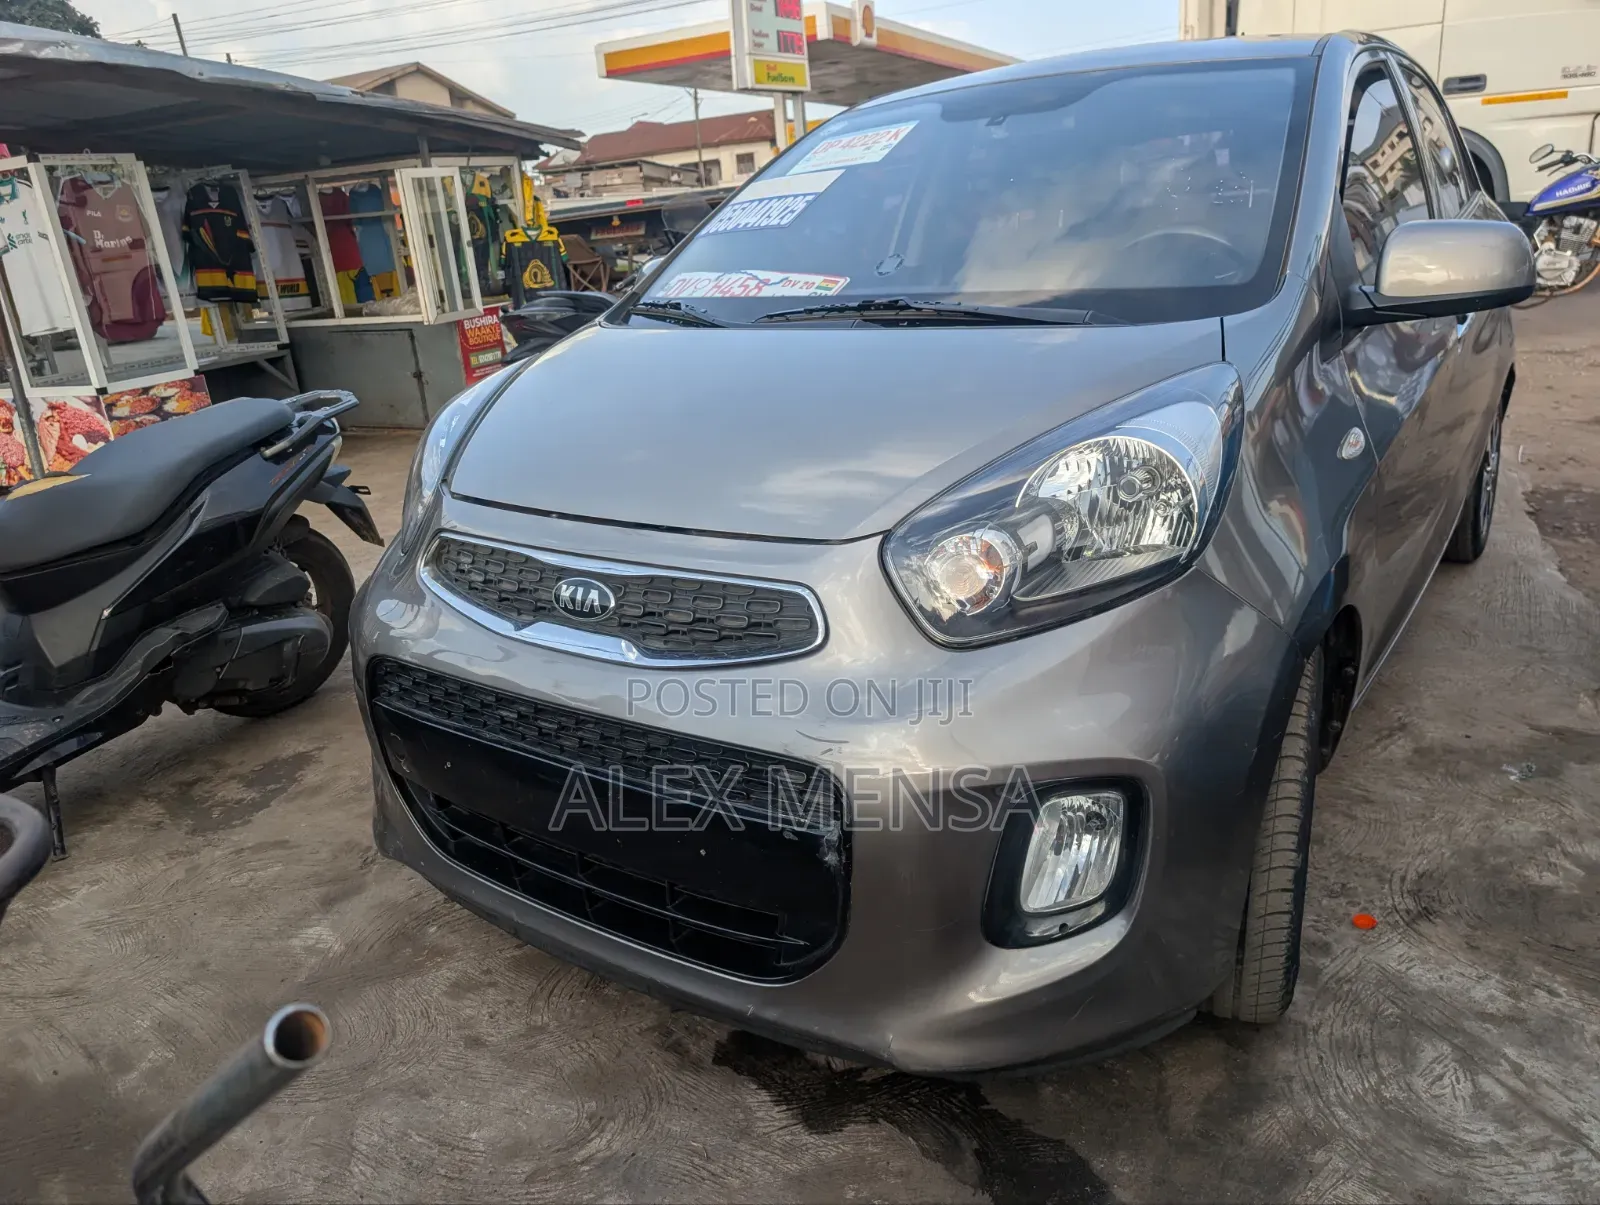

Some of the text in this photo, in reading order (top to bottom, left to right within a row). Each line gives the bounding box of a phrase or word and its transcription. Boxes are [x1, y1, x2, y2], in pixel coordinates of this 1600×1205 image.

[781, 279, 799, 289] DV
[799, 281, 816, 291] 20
[463, 314, 500, 330] BUSHIRA
[466, 323, 502, 338] WAAKYE
[469, 332, 502, 346] BOUTIQUE
[559, 584, 602, 614] KIA
